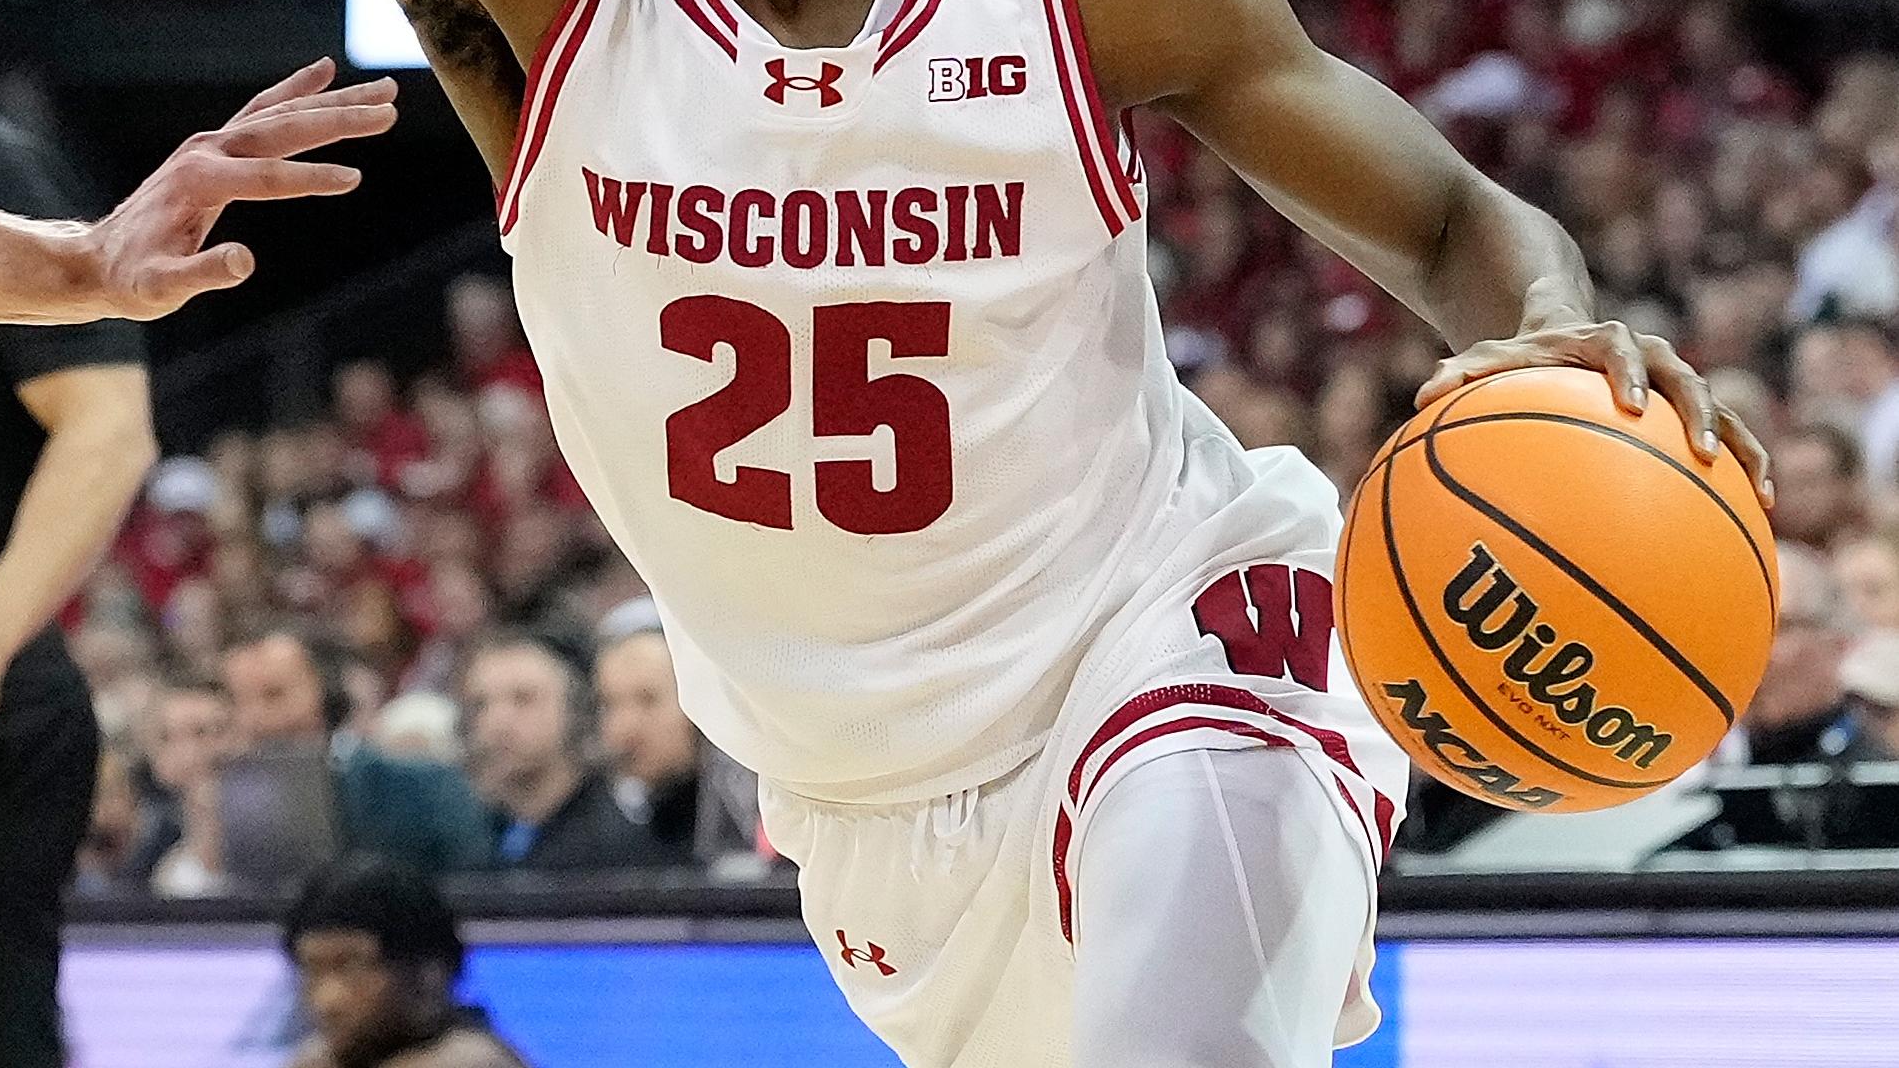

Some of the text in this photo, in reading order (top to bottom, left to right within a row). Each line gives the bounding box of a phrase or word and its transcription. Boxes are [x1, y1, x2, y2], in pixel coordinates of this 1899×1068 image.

[582, 166, 1024, 269] WISCONSIN
[659, 294, 953, 535] 25
[1442, 540, 1674, 770] Wilson
[1497, 682, 1571, 740] EVO NXT
[1381, 679, 1564, 809] NCAA
